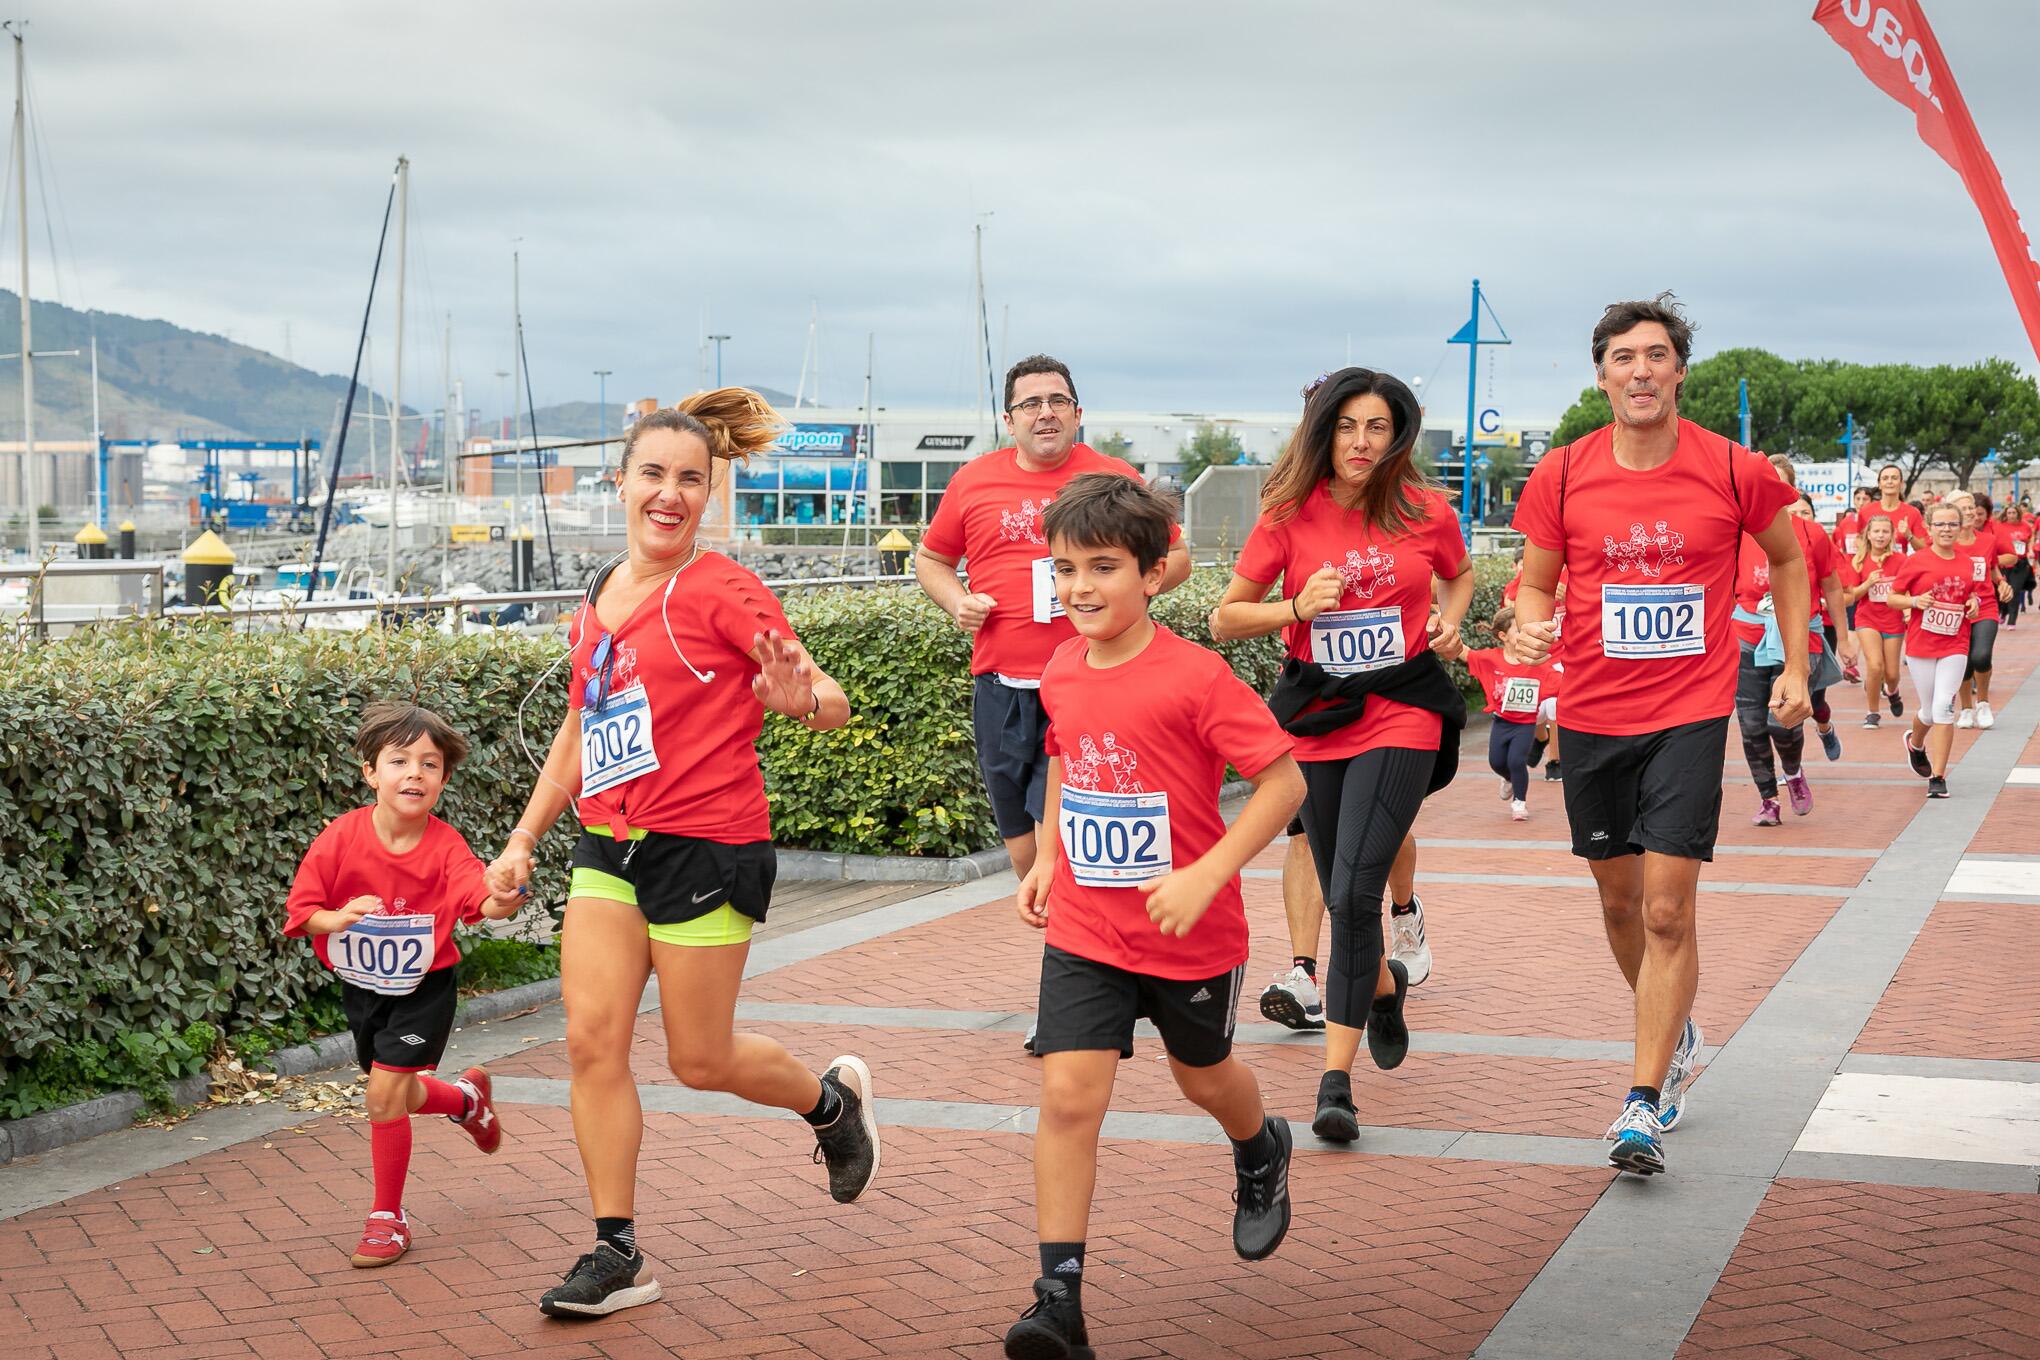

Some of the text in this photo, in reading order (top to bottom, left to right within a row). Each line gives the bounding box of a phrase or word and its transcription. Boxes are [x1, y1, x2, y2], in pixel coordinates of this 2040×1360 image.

[1480, 409, 1500, 433] C
[1614, 604, 1694, 640] 1002
[1927, 609, 1961, 628] 3007
[1320, 626, 1395, 662] 1002
[1067, 816, 1158, 864] 1002
[339, 934, 422, 975] 1002
